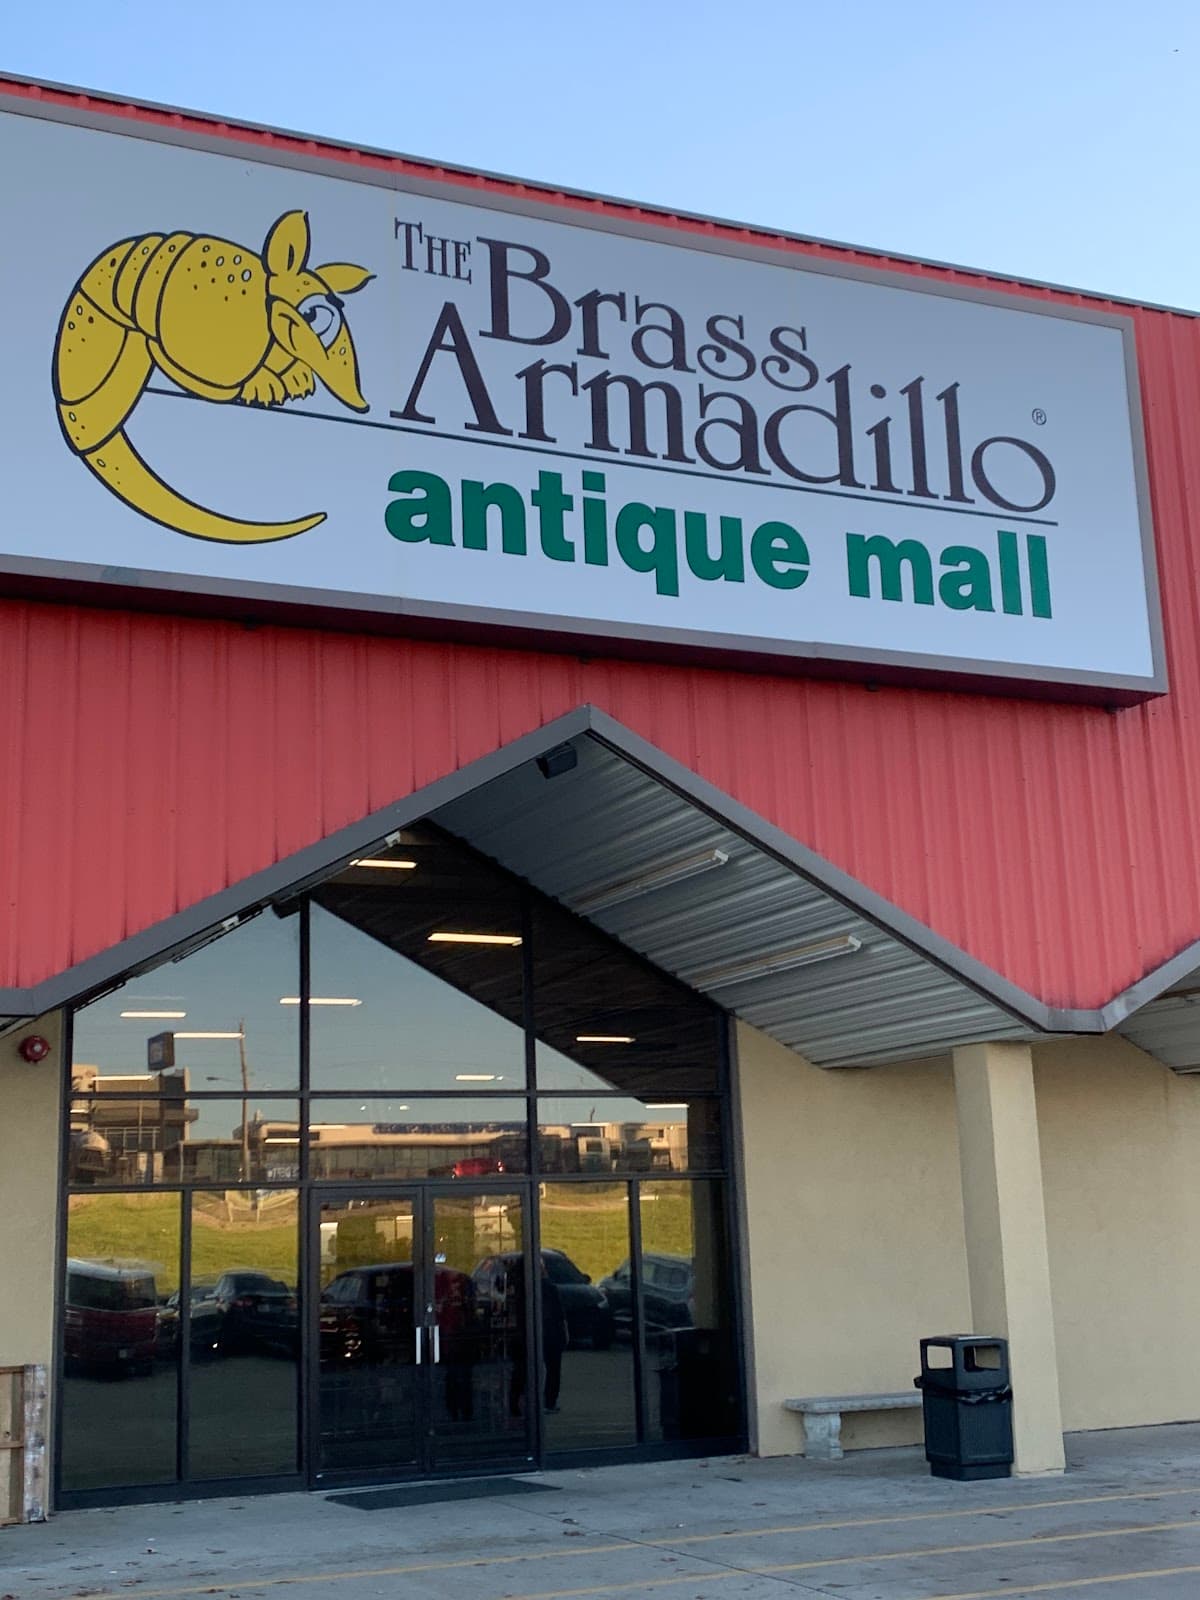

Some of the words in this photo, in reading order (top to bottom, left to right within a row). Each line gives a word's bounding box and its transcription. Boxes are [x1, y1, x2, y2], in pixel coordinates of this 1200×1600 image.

[477, 235, 820, 393] Brass
[389, 301, 1057, 513] Armadillo
[384, 469, 811, 598] antique
[845, 529, 1053, 619] mall
